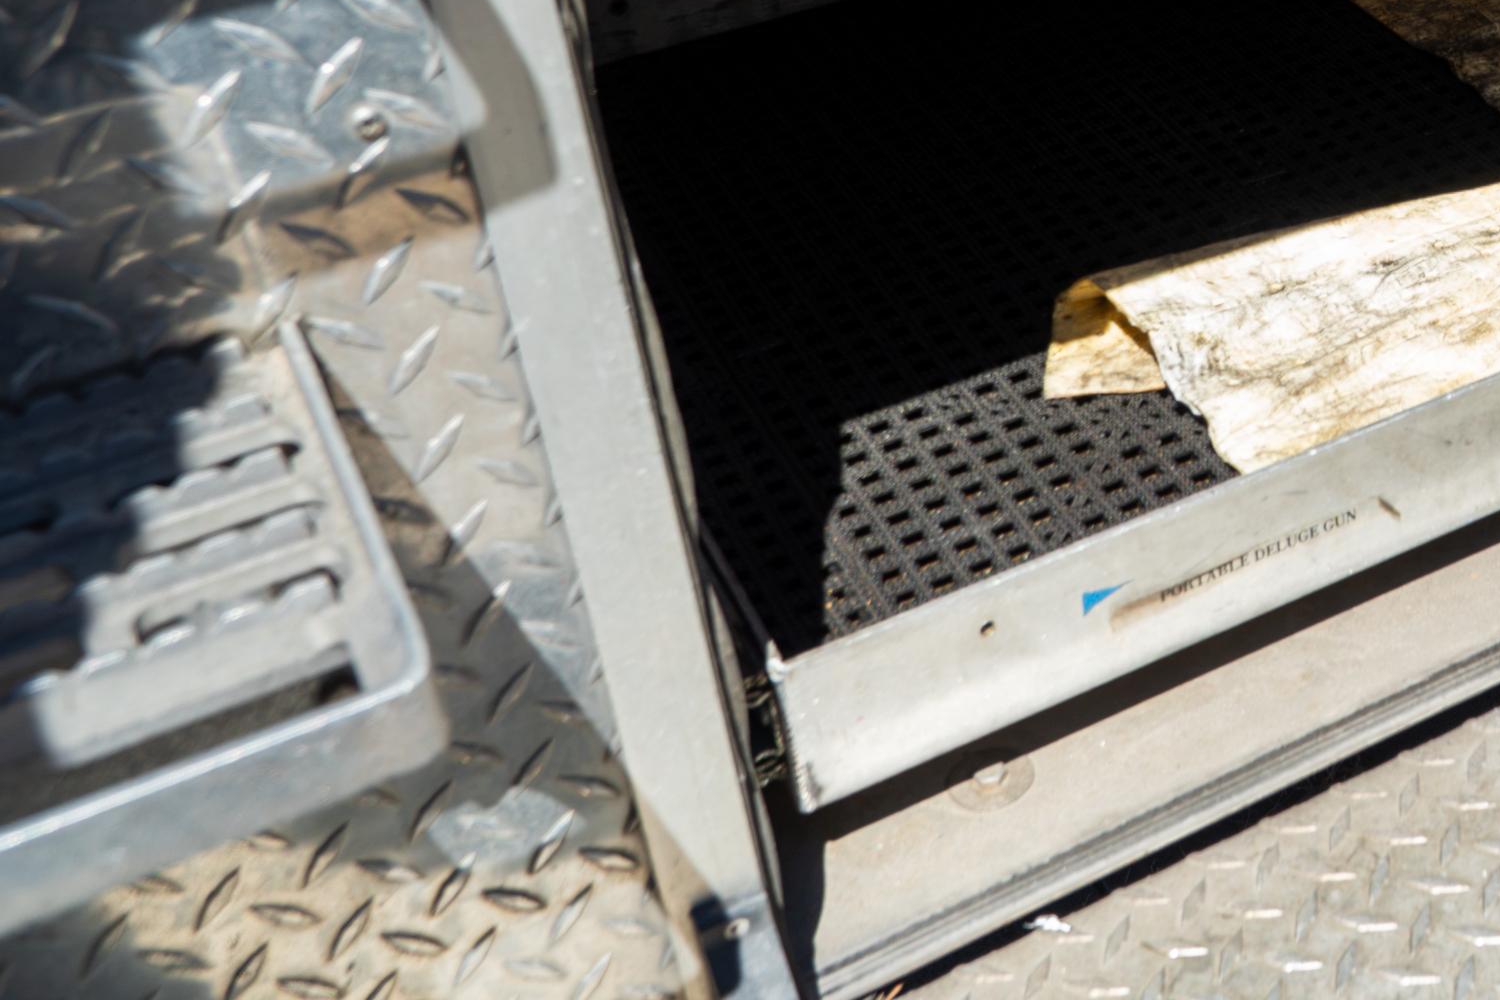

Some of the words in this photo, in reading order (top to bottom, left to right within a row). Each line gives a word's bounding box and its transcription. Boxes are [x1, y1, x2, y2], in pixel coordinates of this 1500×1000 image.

[1160, 553, 1250, 602] PORTABLE
[1254, 526, 1319, 562] DELUGE
[1322, 508, 1358, 533] GUN
